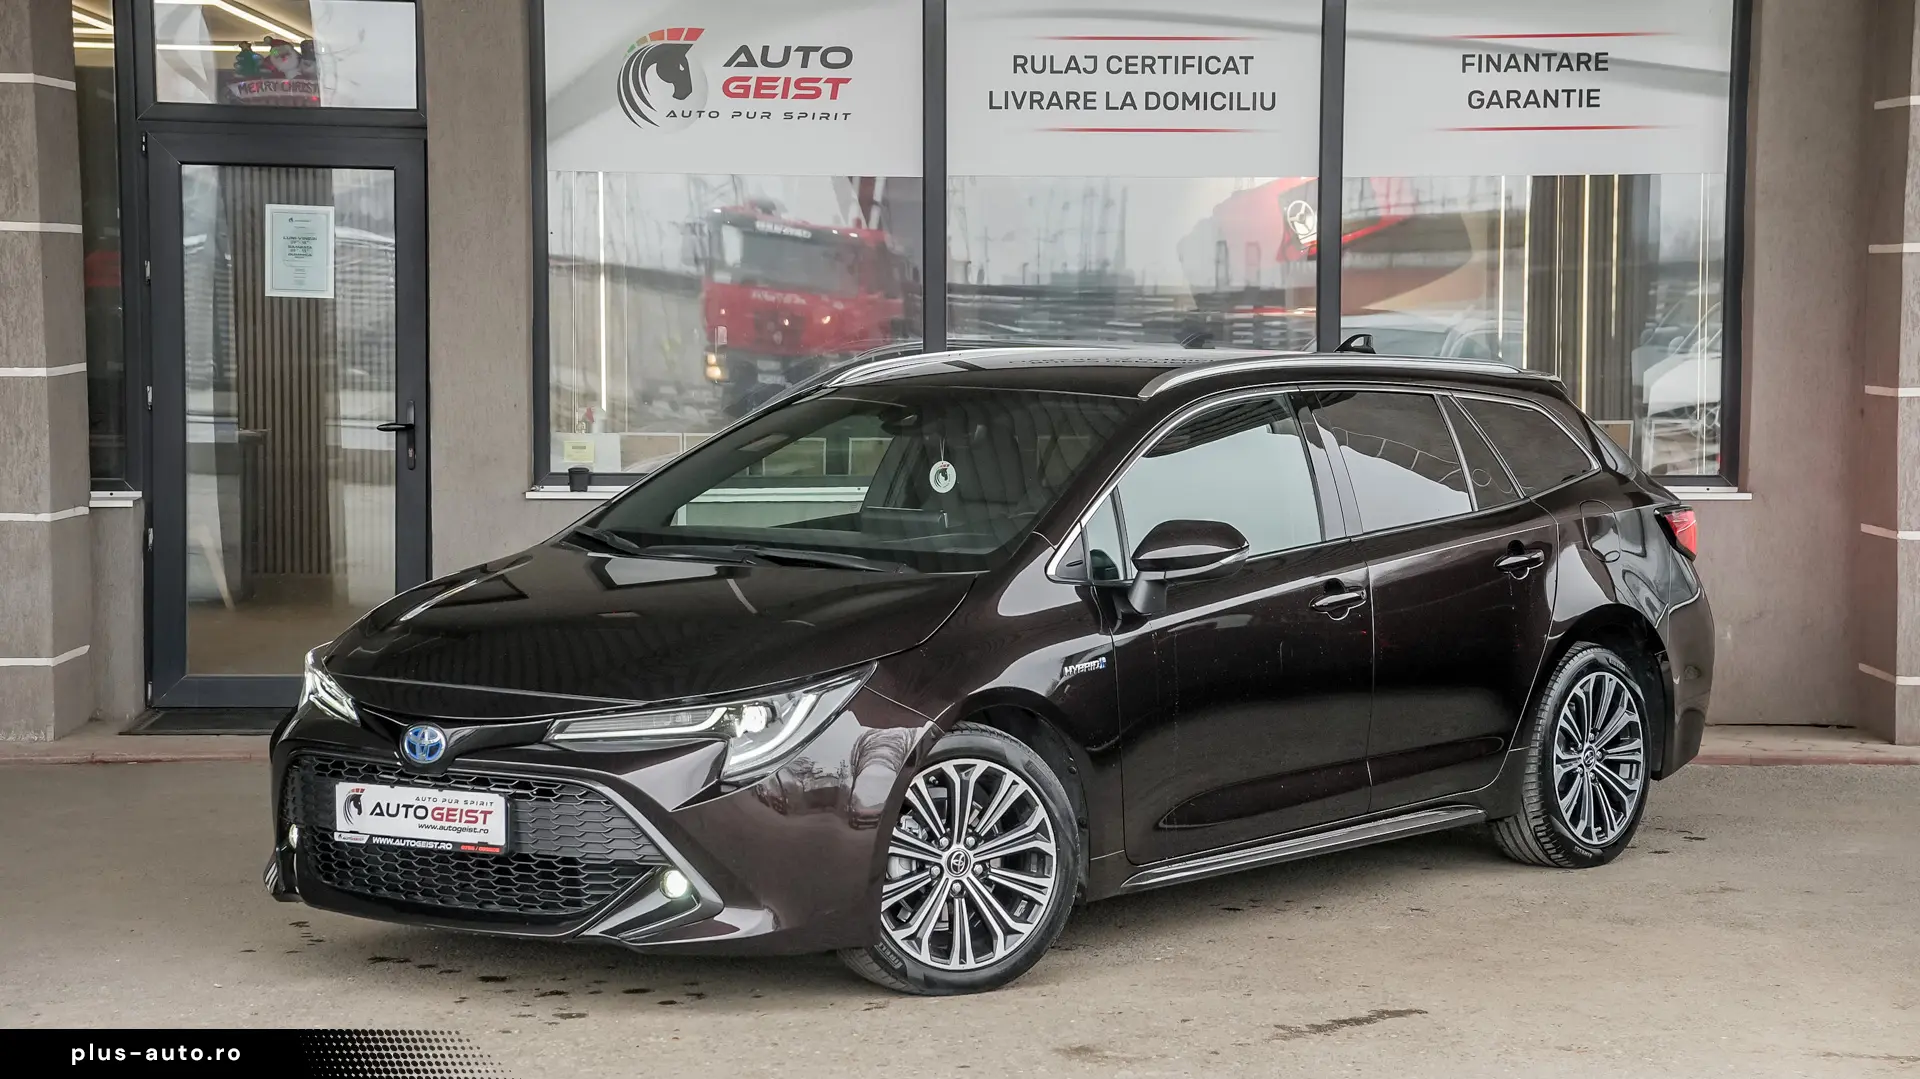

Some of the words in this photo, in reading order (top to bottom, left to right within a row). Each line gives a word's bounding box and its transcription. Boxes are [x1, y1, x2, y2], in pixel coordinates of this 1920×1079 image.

[722, 44, 854, 70] AUTO
[1012, 54, 1098, 75] RULAJ
[1105, 55, 1255, 75] CERTIFICAT
[1461, 52, 1609, 74] FINANTARE
[281, 80, 319, 95] CHRIST
[721, 75, 853, 101] GEIST
[988, 90, 1097, 111] LIVRARE
[1105, 91, 1138, 111] LA
[1144, 91, 1277, 112] DOMICILIU
[1467, 88, 1601, 110] GARANTIE
[665, 110, 720, 119] AUTO
[731, 110, 772, 120] PUR
[783, 111, 852, 121] SPIRIT
[1064, 659, 1100, 677] HYBRID
[463, 799, 494, 807] SPIRIT
[418, 822, 489, 834] www.autogeist.ro
[372, 836, 453, 851] WWW.AUTOGEIST.RO
